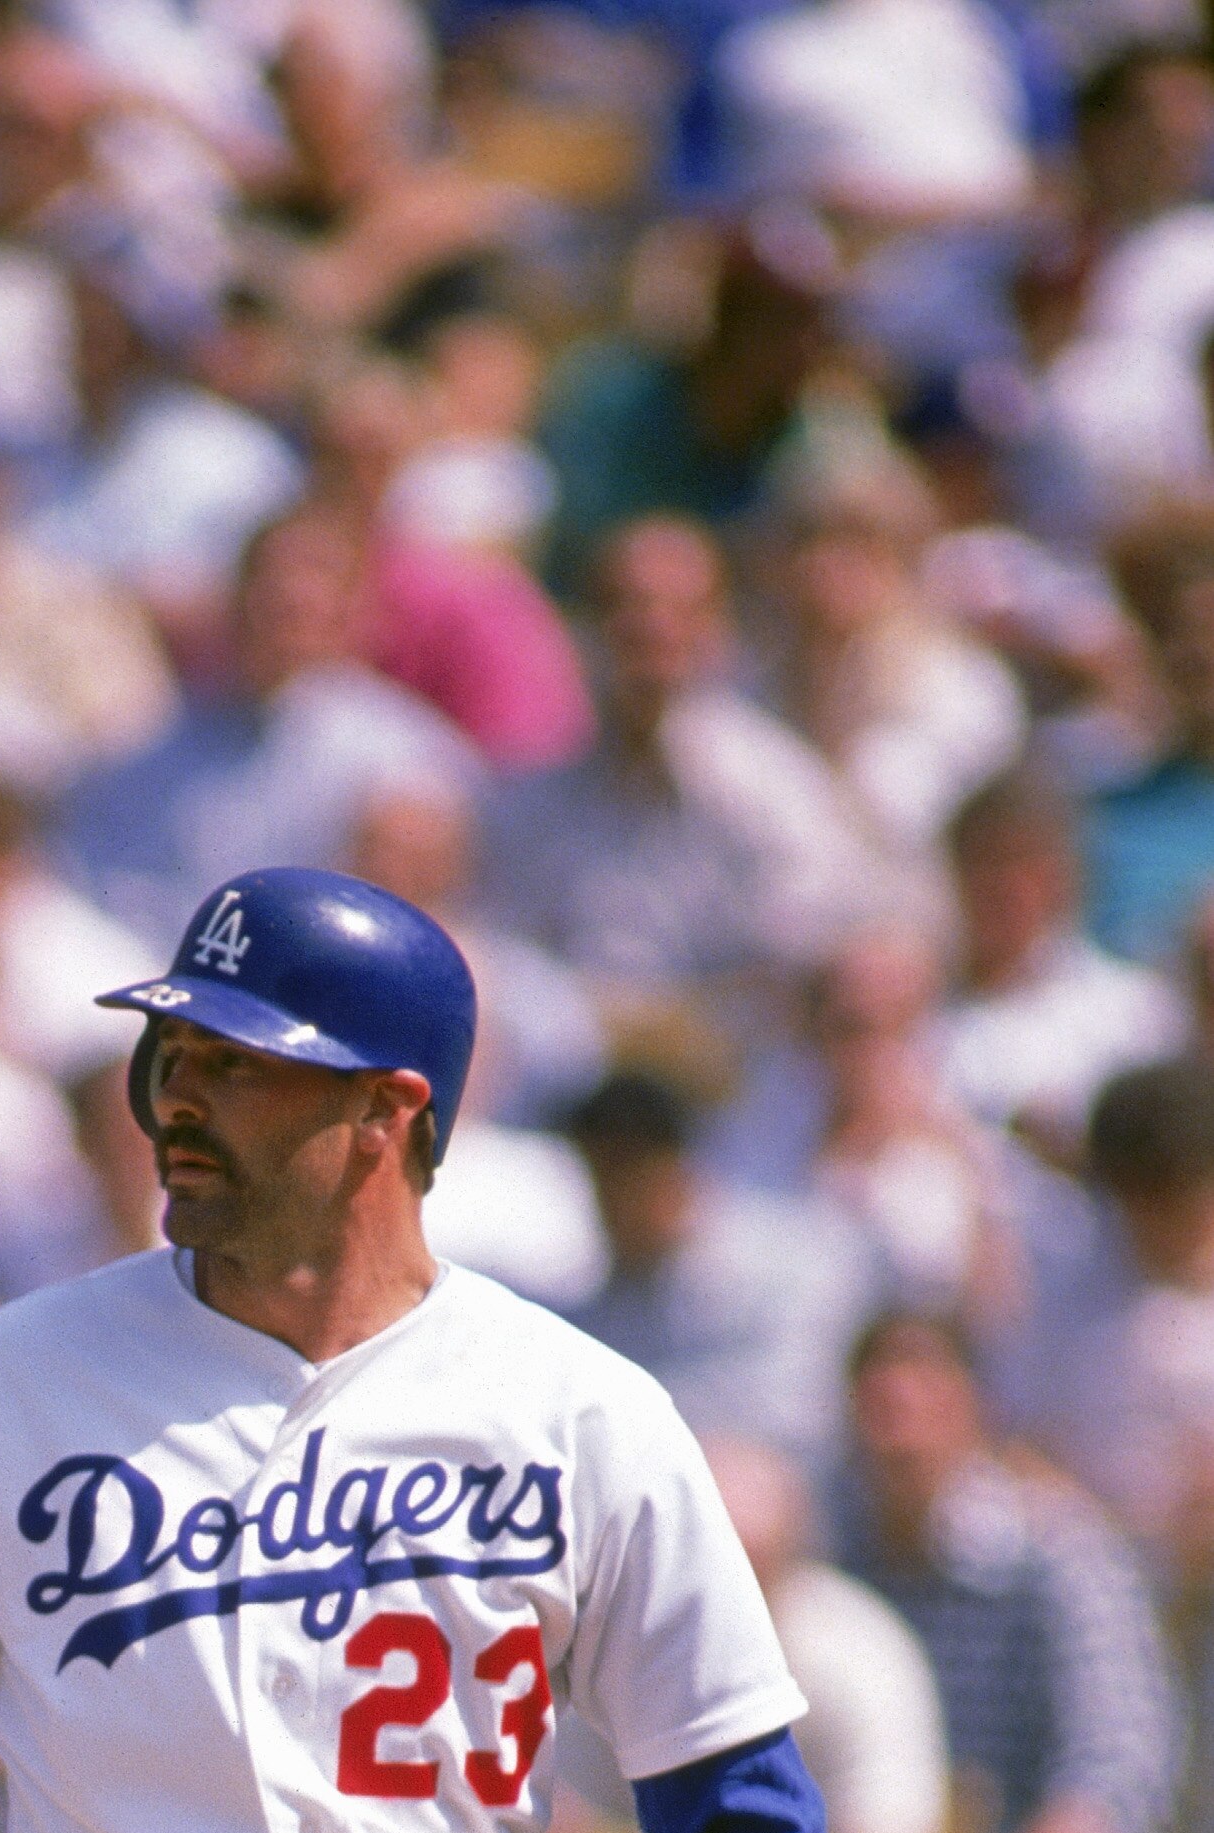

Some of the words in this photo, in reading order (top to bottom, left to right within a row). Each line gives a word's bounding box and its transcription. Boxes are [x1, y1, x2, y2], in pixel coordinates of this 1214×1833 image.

[193, 890, 251, 976] LA
[17, 1425, 567, 1642] Dodgers
[336, 1611, 554, 1808] 23
